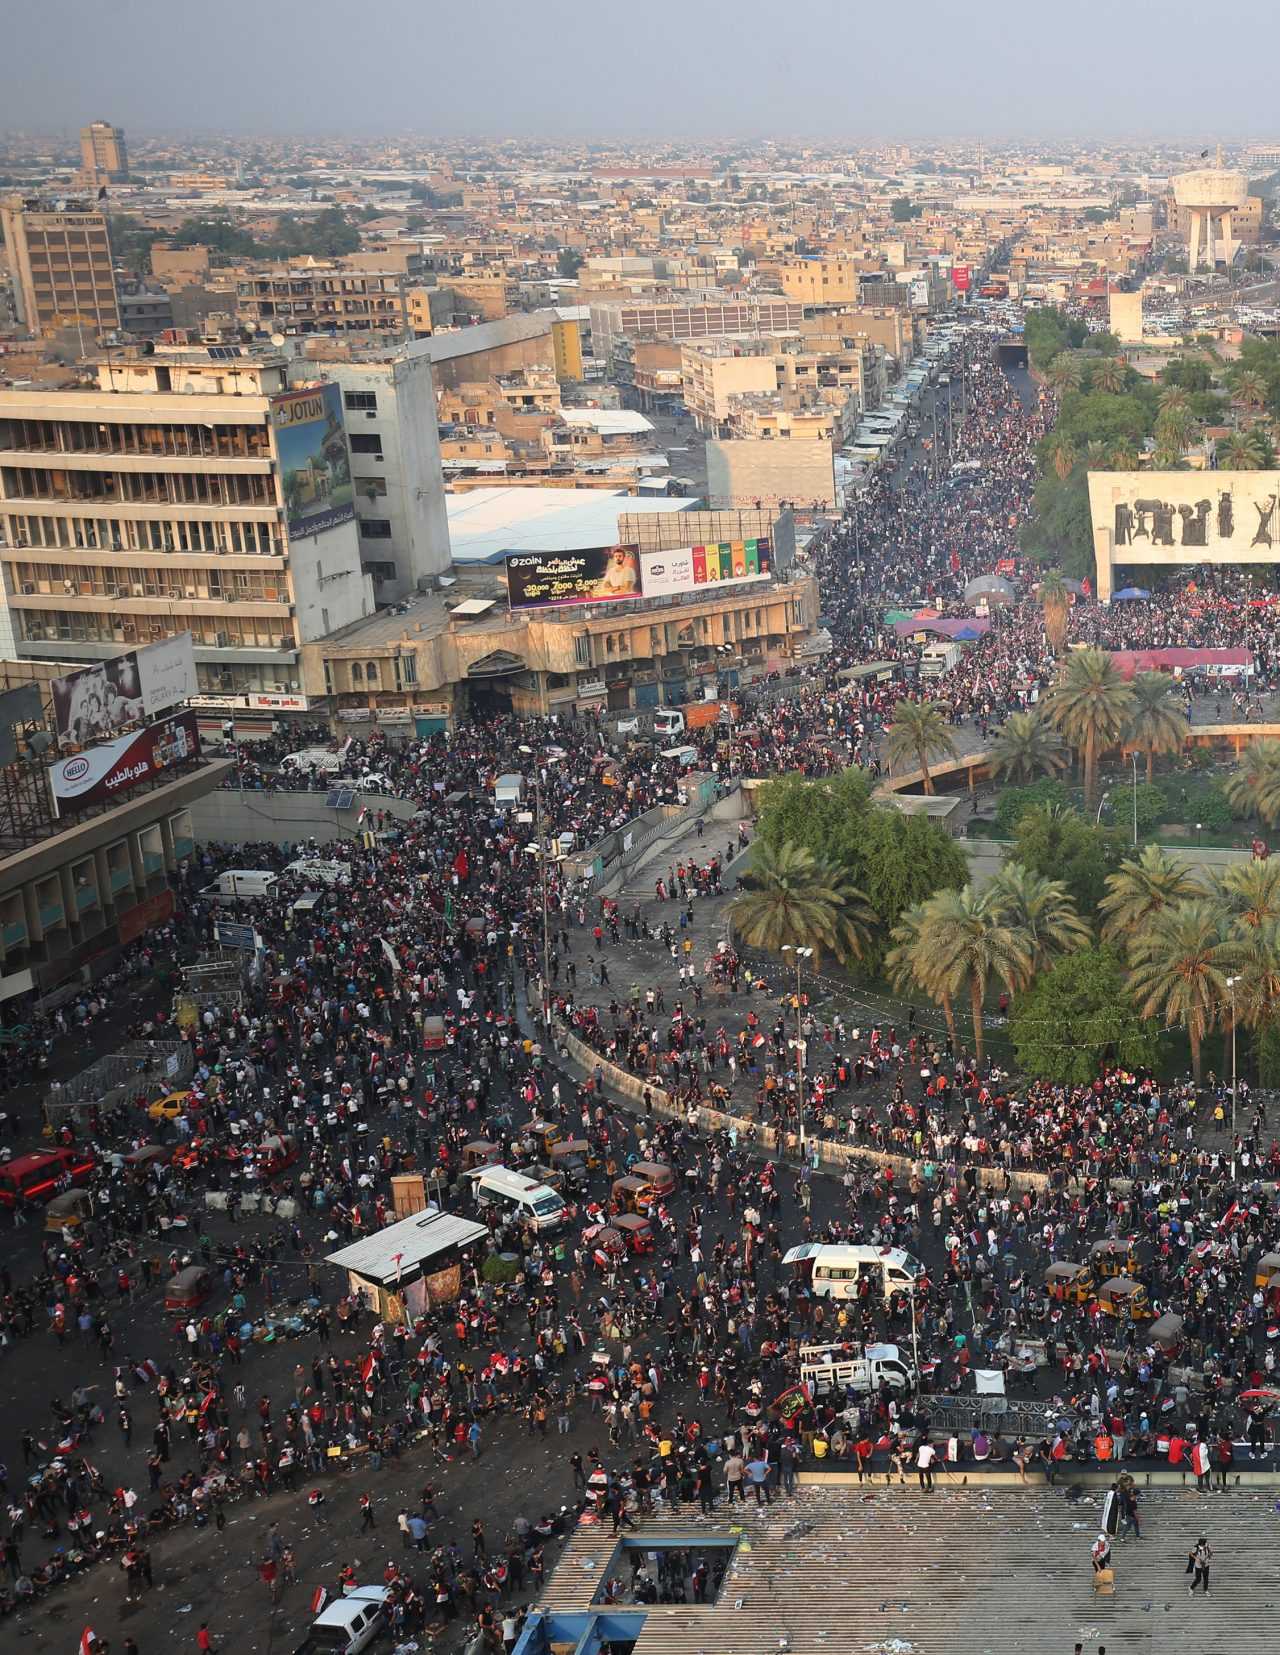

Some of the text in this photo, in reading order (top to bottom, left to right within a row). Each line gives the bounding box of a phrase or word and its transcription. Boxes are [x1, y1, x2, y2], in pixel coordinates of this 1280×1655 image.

[289, 398, 322, 422] JOTUN
[66, 763, 86, 778] HELLO
[105, 766, 134, 789] بالطيب
[133, 761, 150, 777] هلو
